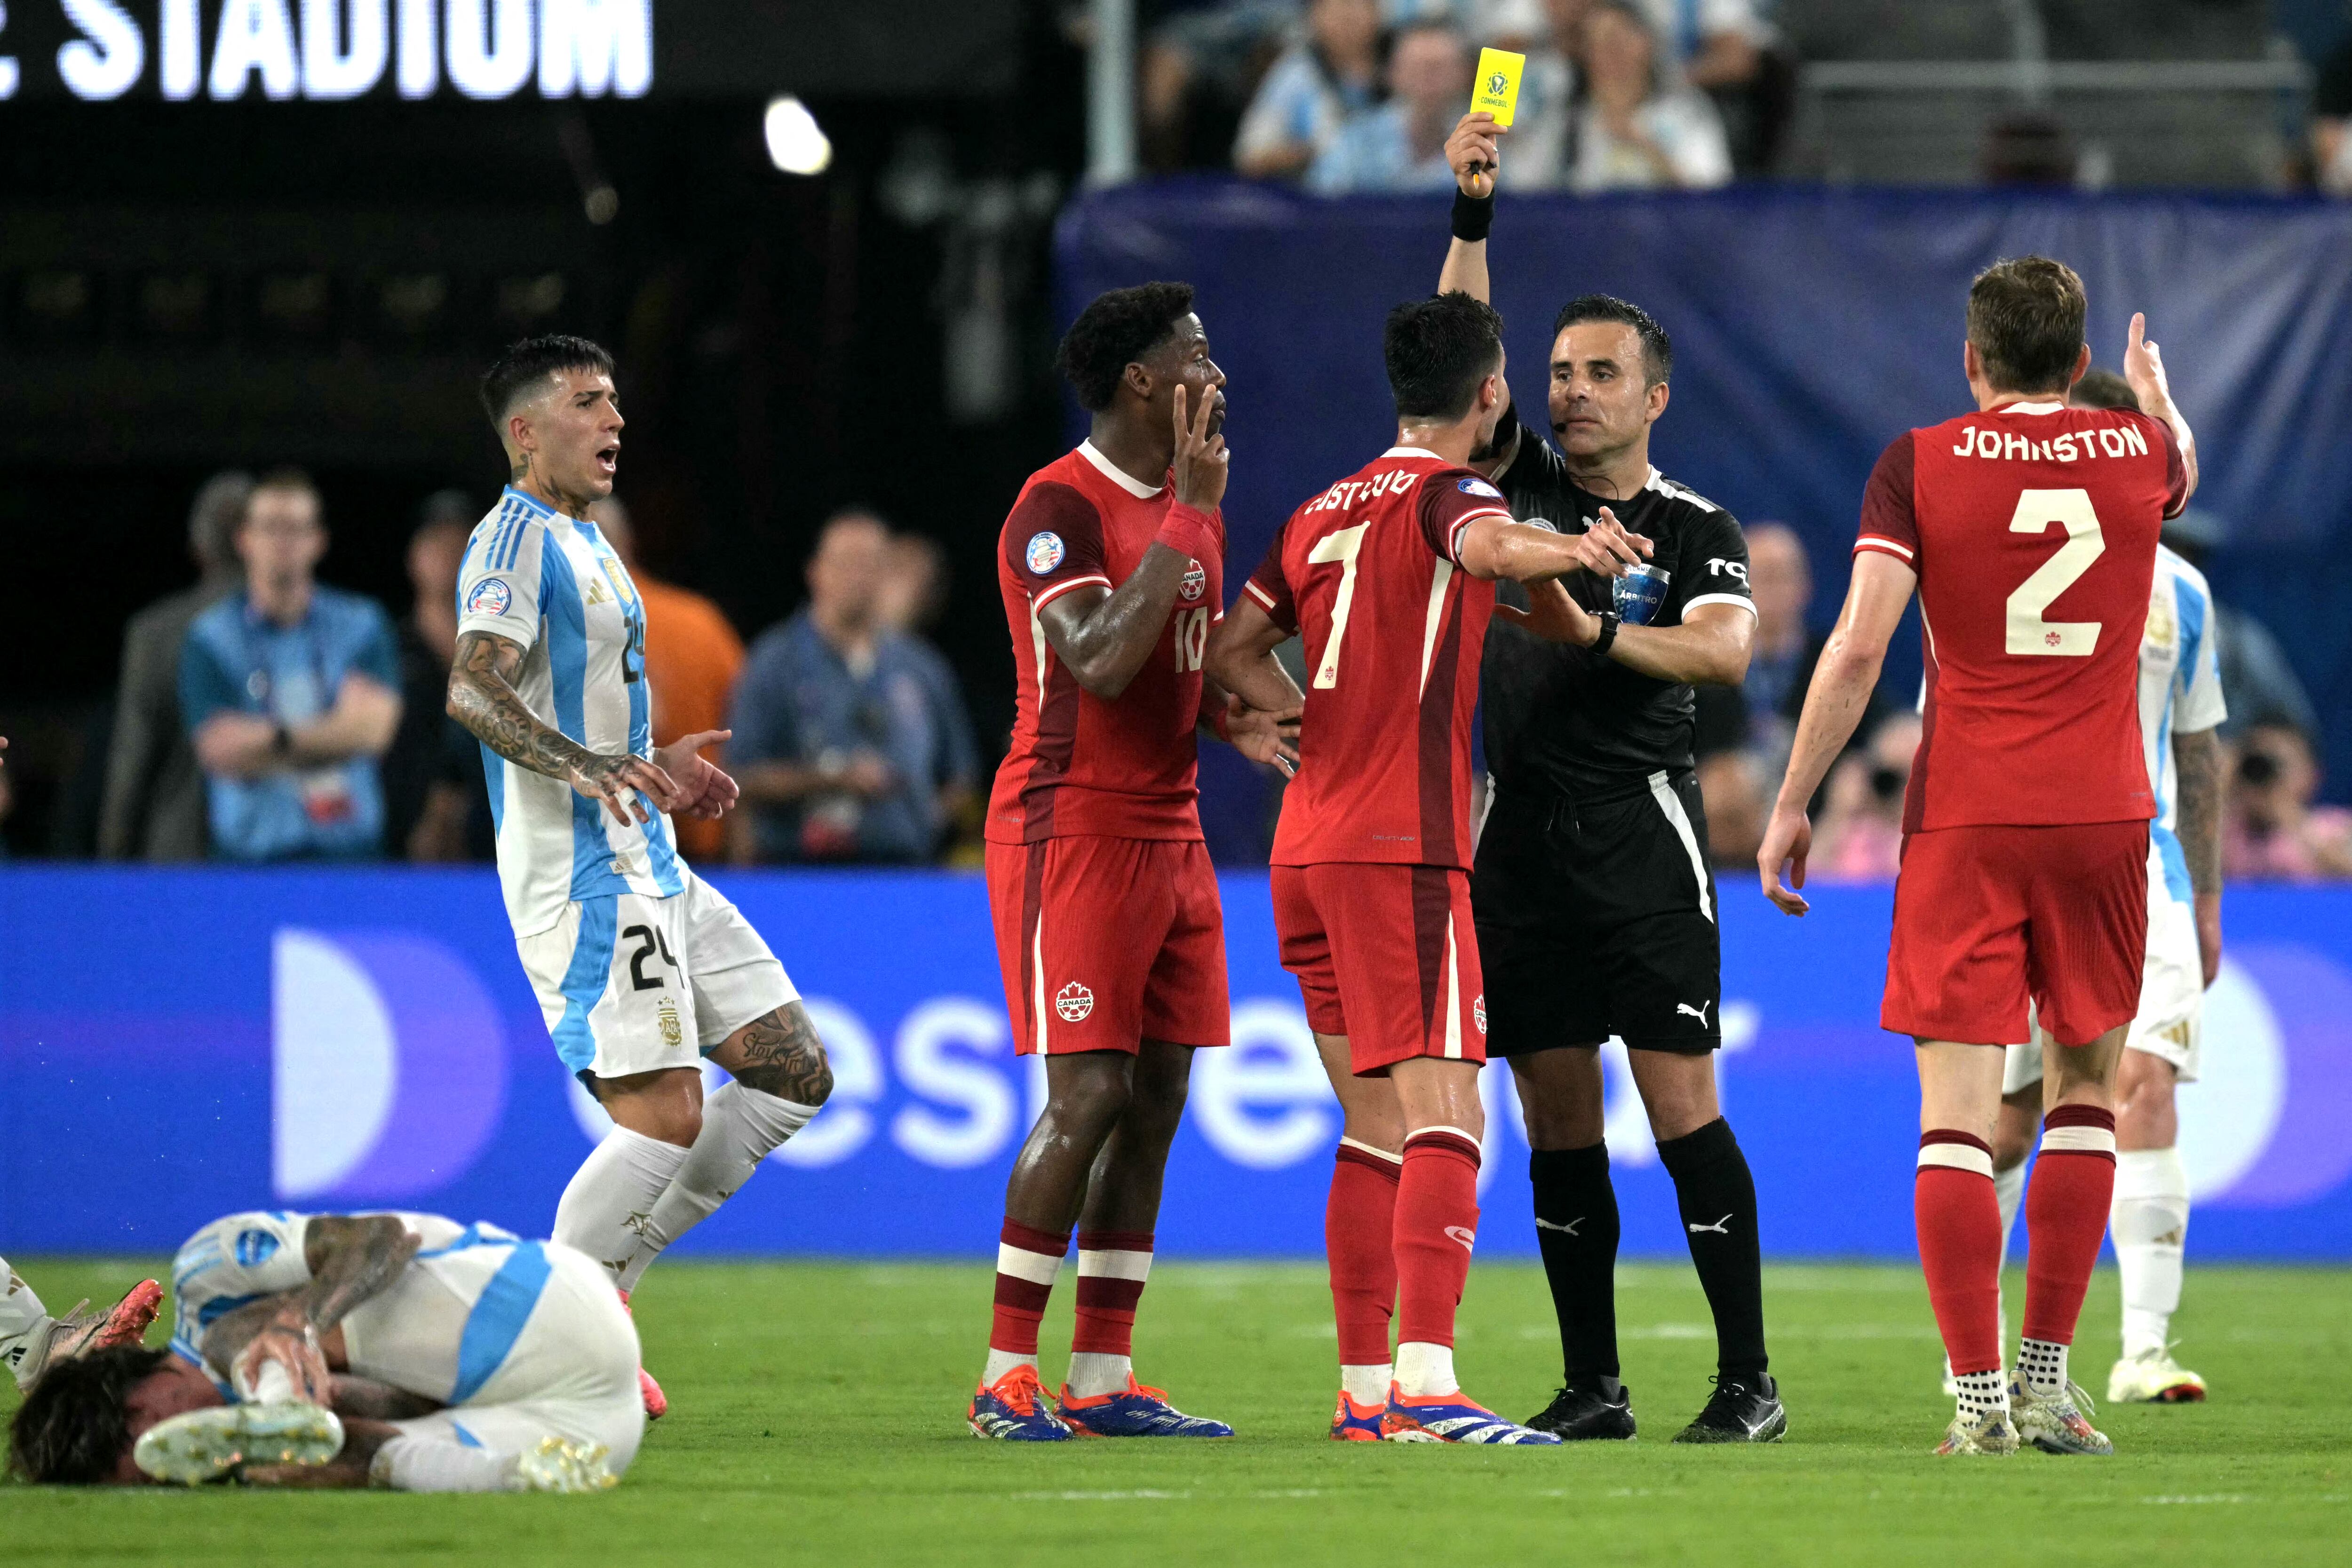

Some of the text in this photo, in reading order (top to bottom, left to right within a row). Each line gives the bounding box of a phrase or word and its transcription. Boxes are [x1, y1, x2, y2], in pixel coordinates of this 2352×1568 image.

[1481, 96, 1508, 108] CONMEBOL
[1953, 424, 2148, 462] JOHNSTON
[1183, 572, 1204, 581] ANADA
[2005, 488, 2106, 656] 2
[1308, 520, 1371, 689] 7
[1620, 589, 1657, 604] ÁRBITRO
[1174, 606, 1208, 673] 10
[622, 924, 685, 992] 24
[1057, 998, 1091, 1007] CANADA
